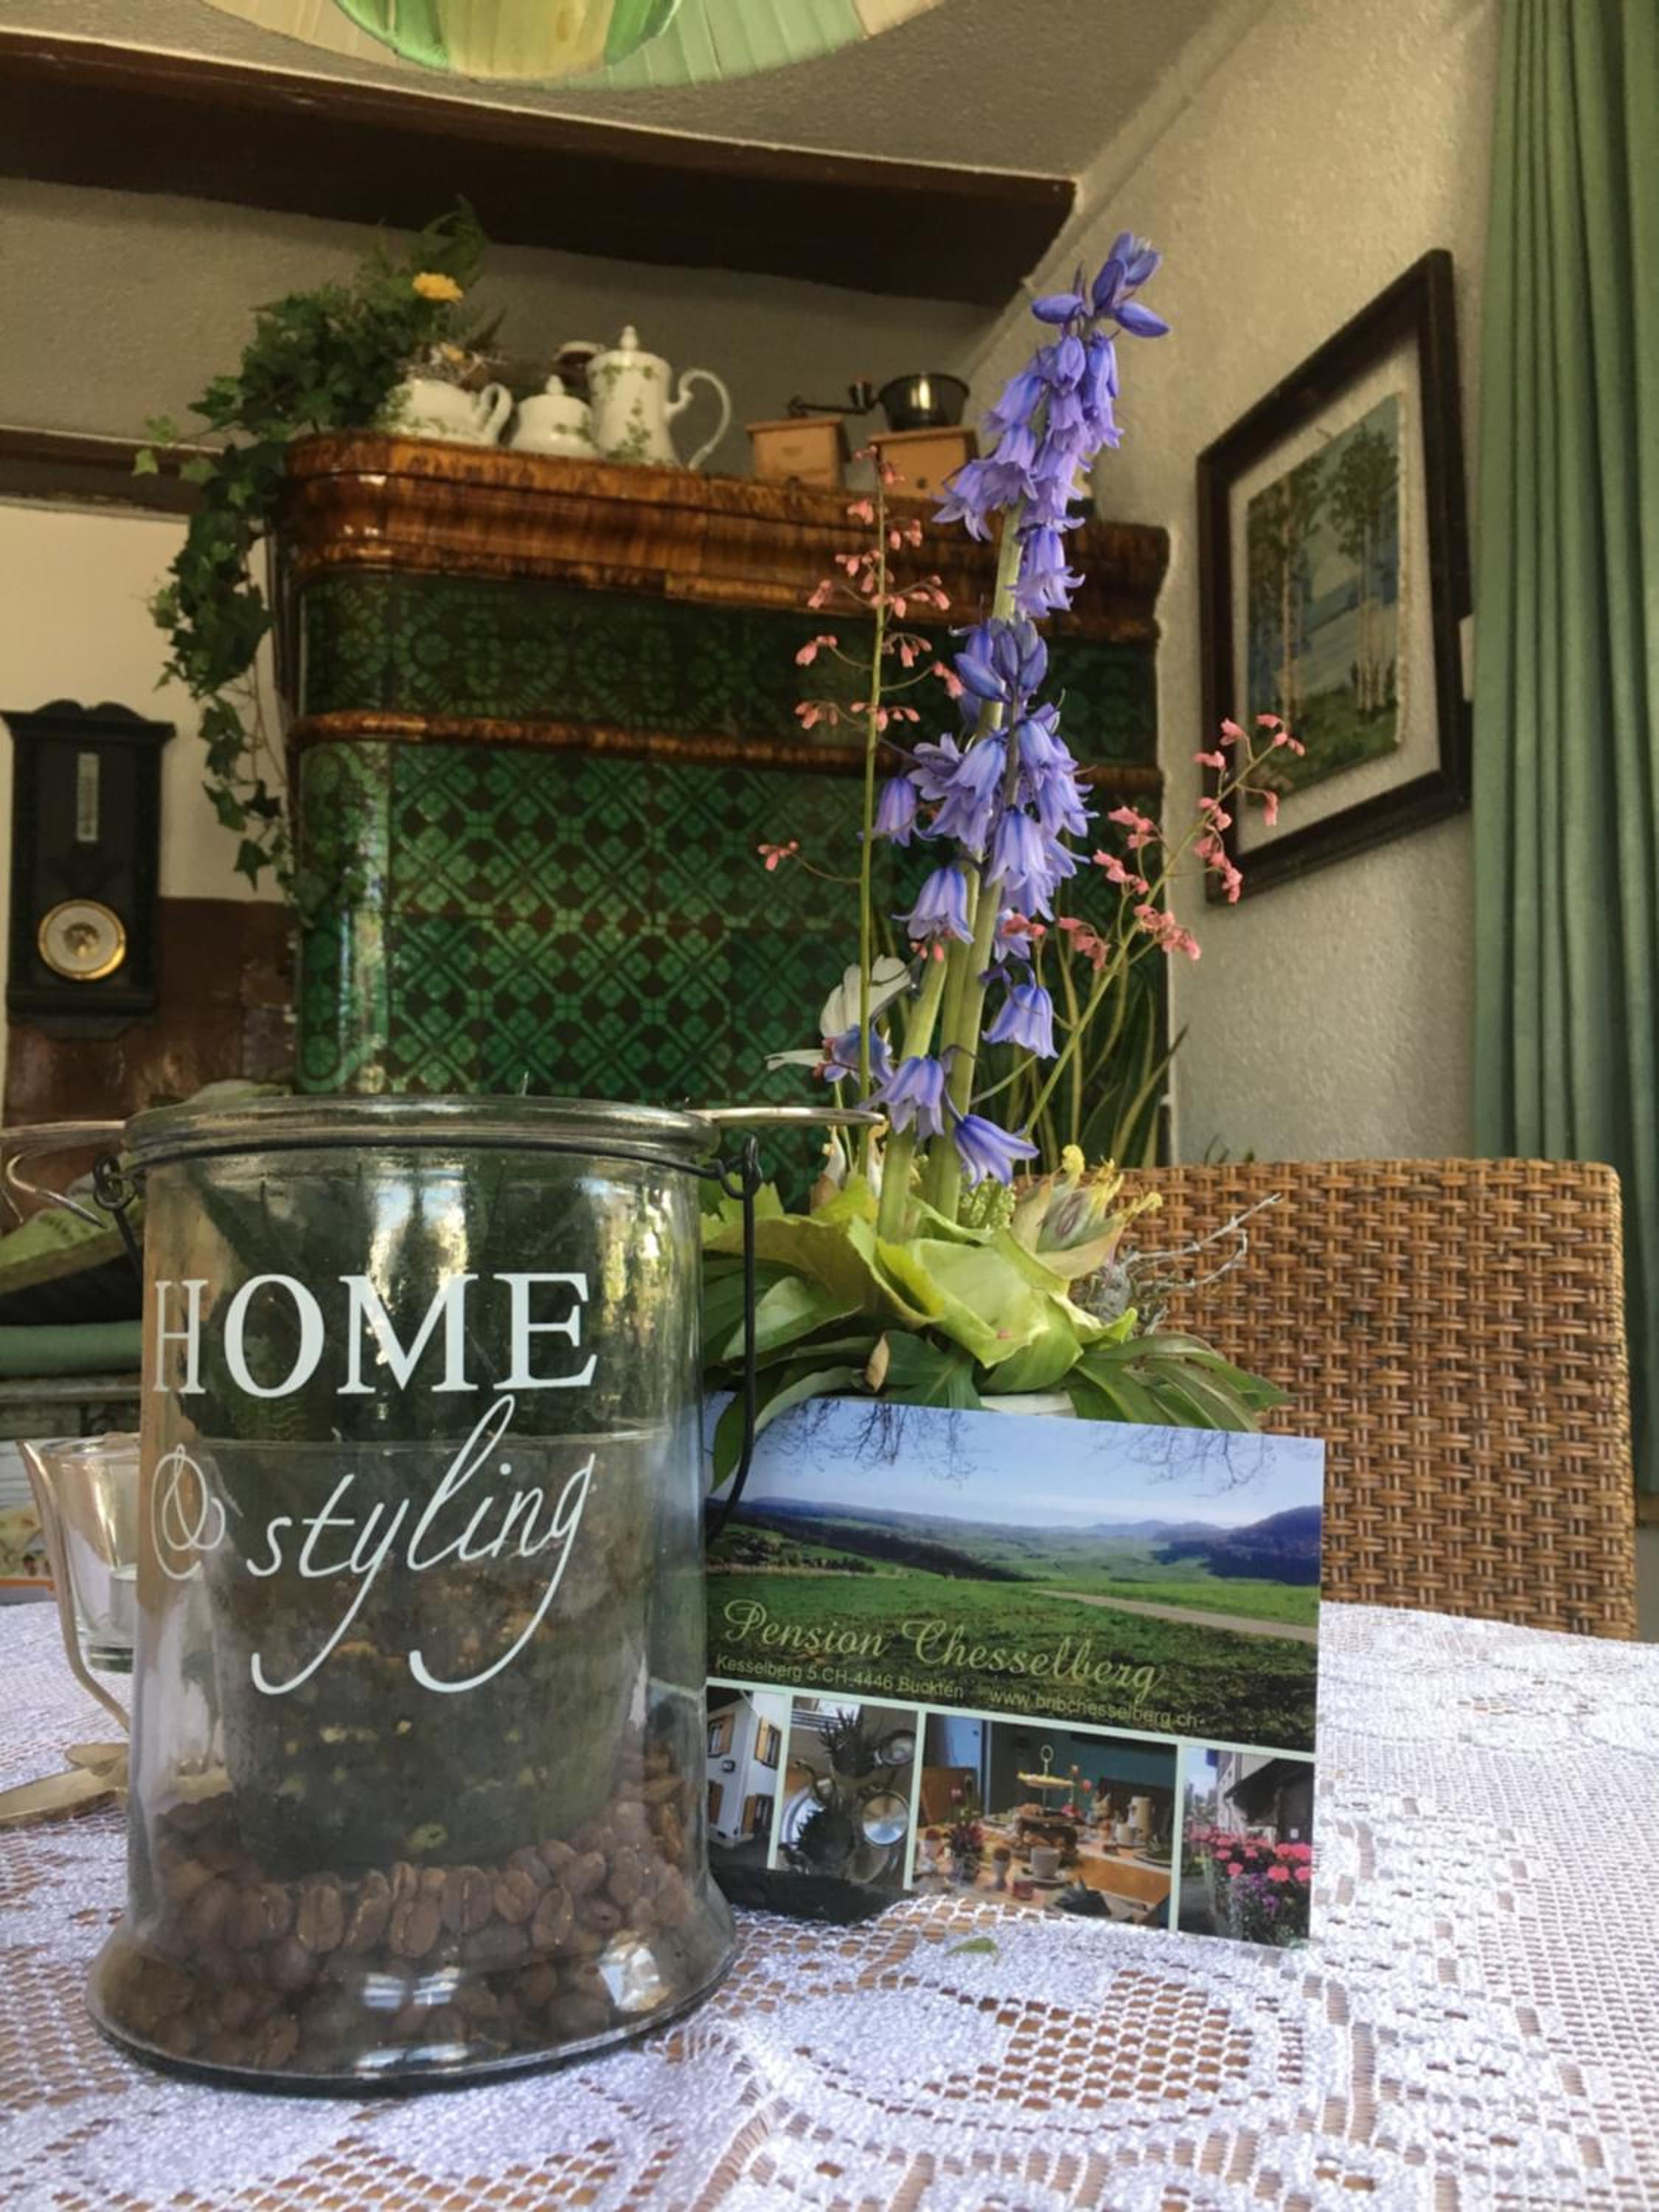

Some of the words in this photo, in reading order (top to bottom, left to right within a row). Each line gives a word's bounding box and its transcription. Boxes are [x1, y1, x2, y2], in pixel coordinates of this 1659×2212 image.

[153, 1273, 597, 1398] HOME
[246, 1394, 595, 1694] styling
[717, 1654, 802, 1682] Kesselberg
[898, 1676, 964, 1699] Buckten
[724, 1599, 891, 1657] Pension
[901, 1620, 1169, 1703] Chesselberg
